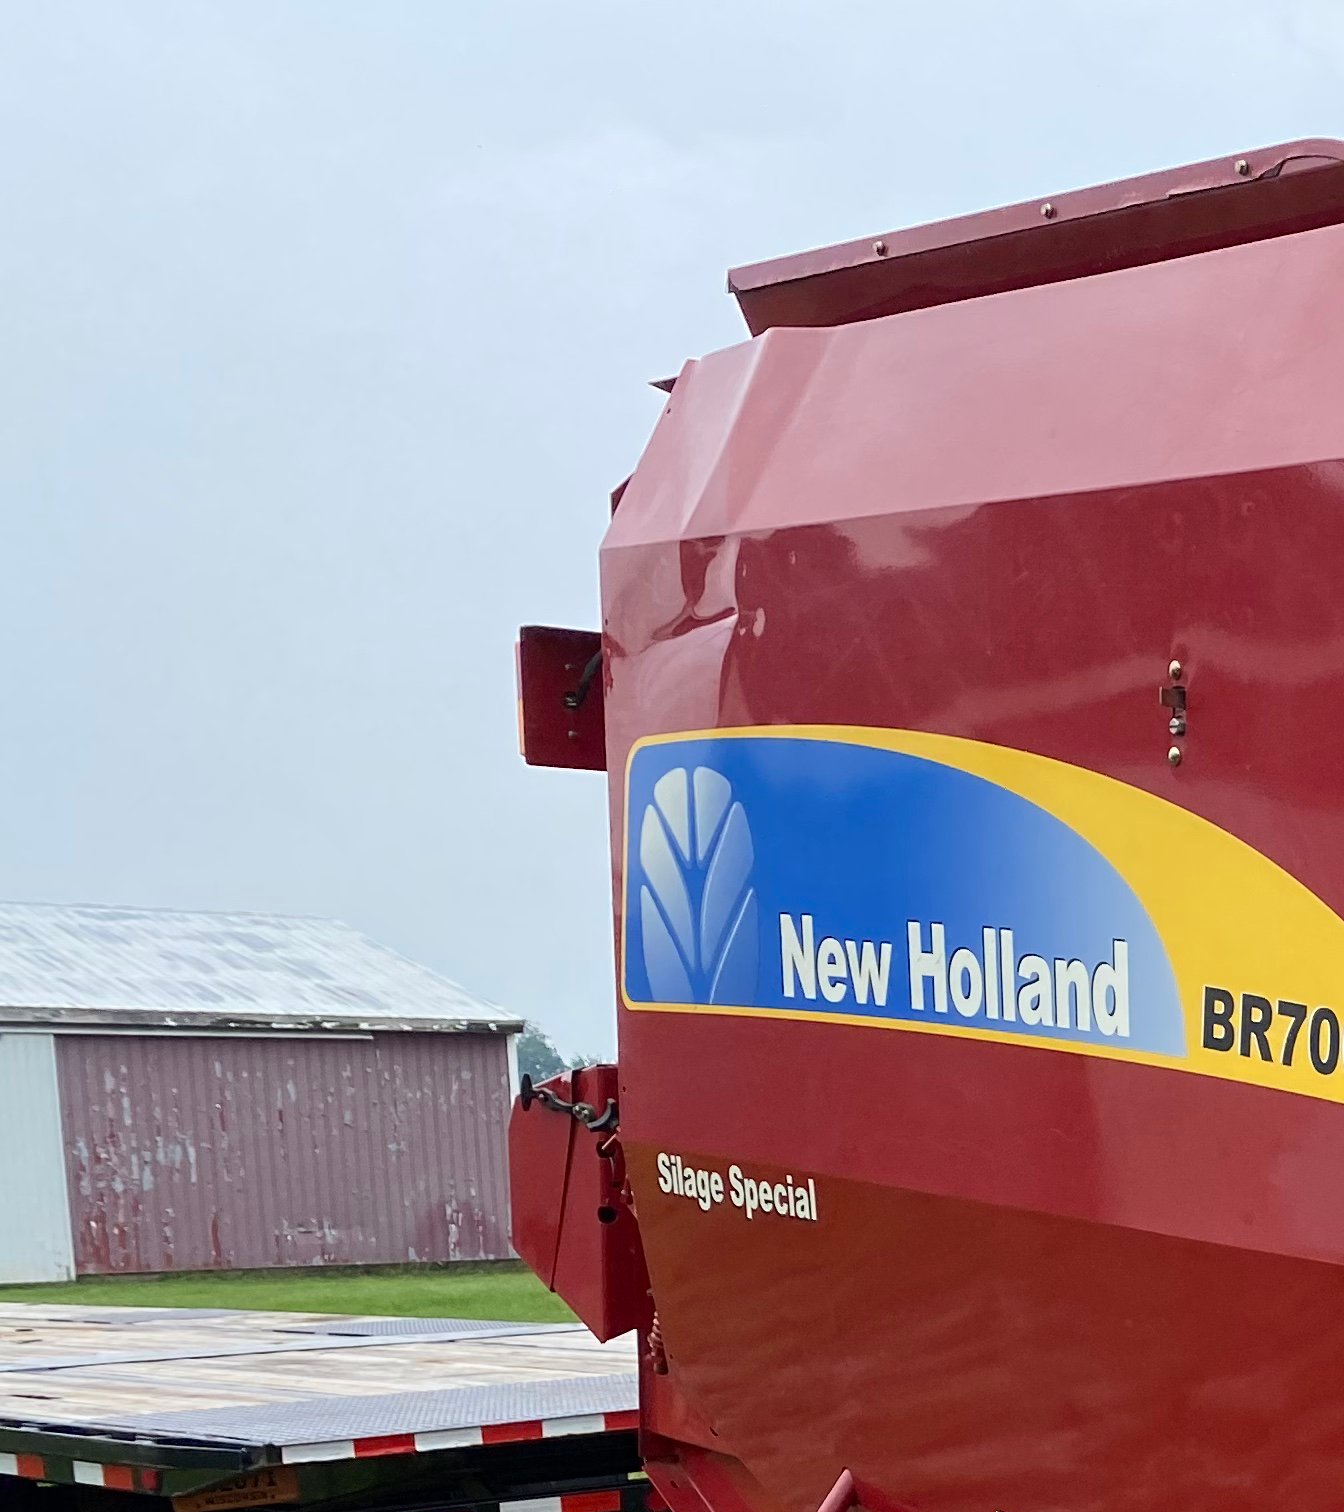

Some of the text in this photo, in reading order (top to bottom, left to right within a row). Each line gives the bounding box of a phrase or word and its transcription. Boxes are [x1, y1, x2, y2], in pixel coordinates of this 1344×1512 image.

[780, 913, 1130, 1039] New Holland
[656, 1152, 818, 1222] Silage Special
